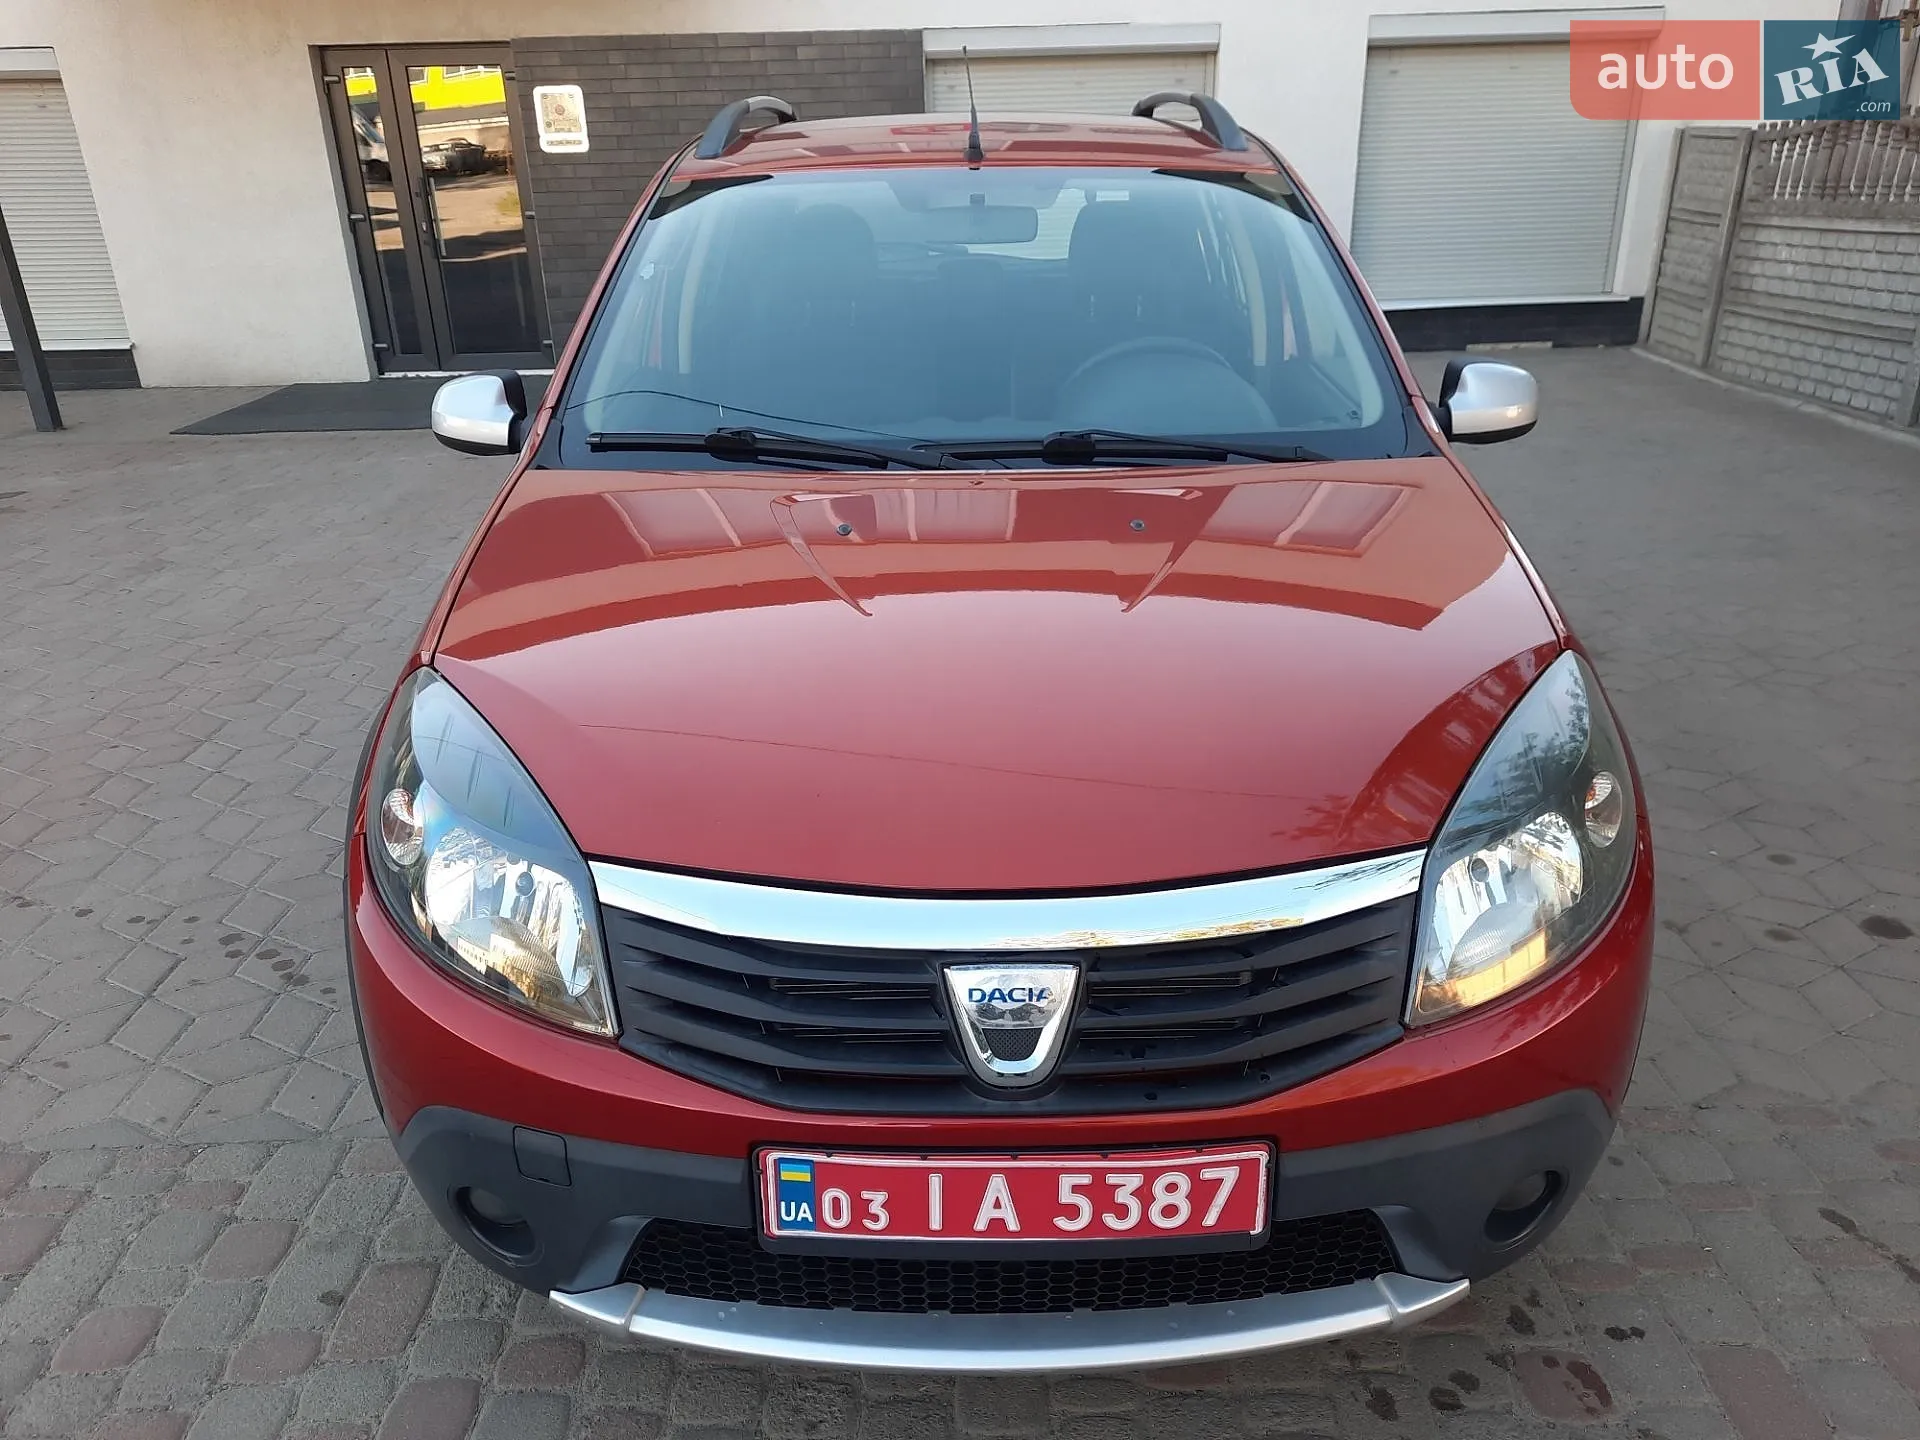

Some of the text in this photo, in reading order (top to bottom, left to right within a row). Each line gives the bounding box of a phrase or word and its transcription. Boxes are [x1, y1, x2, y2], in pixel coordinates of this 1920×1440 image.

[780, 1201, 813, 1223] UA
[821, 1187, 890, 1232] 03
[1052, 1165, 1241, 1232] 5387
